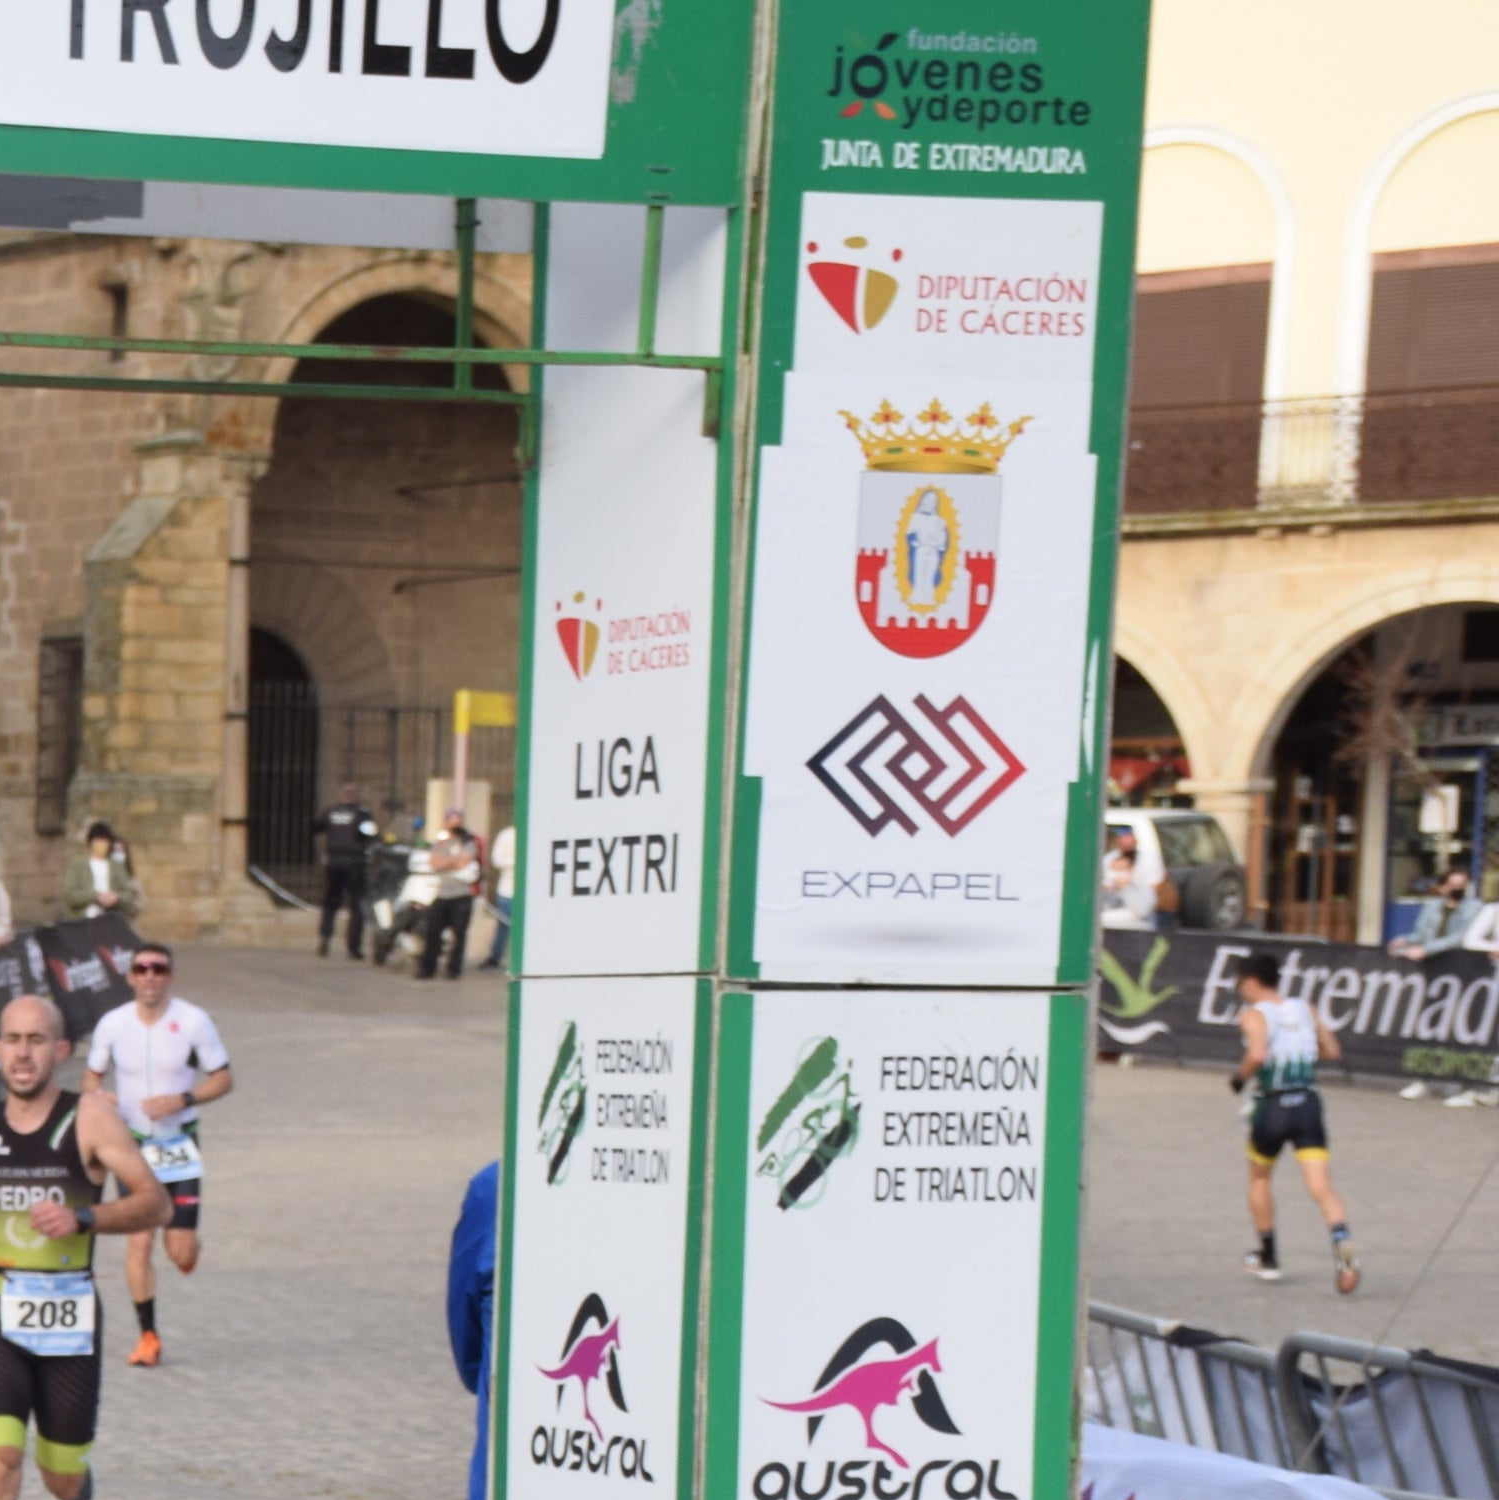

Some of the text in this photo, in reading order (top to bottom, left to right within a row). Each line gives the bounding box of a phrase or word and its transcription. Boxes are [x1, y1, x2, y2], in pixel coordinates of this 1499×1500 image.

[908, 29, 1038, 54] fundación
[828, 32, 1044, 98] jóvenes
[821, 139, 1087, 174] JUNTA DE EXTREMADURA
[917, 273, 1088, 303] DIPUTACIÓN
[915, 305, 1085, 337] DE CÁCERES
[608, 606, 691, 643] DIPUTACIÓN
[608, 642, 690, 675] DE CÁCERES
[574, 735, 662, 800] LIGA
[549, 833, 679, 898] FEXTRI
[803, 870, 1020, 902] EXPAPEL
[1197, 945, 1499, 1046] Etremad
[596, 1031, 674, 1074] FEDERACIÓN
[880, 1047, 1040, 1092] FEDERACIÓN
[596, 1089, 669, 1129] EXTREMEÑA
[883, 1104, 1032, 1148] EXTREMEÑA
[591, 1147, 607, 1182] DE
[874, 1166, 1038, 1203] DE TRIATLON
[17, 1299, 78, 1329] 208
[530, 1424, 654, 1482] austral
